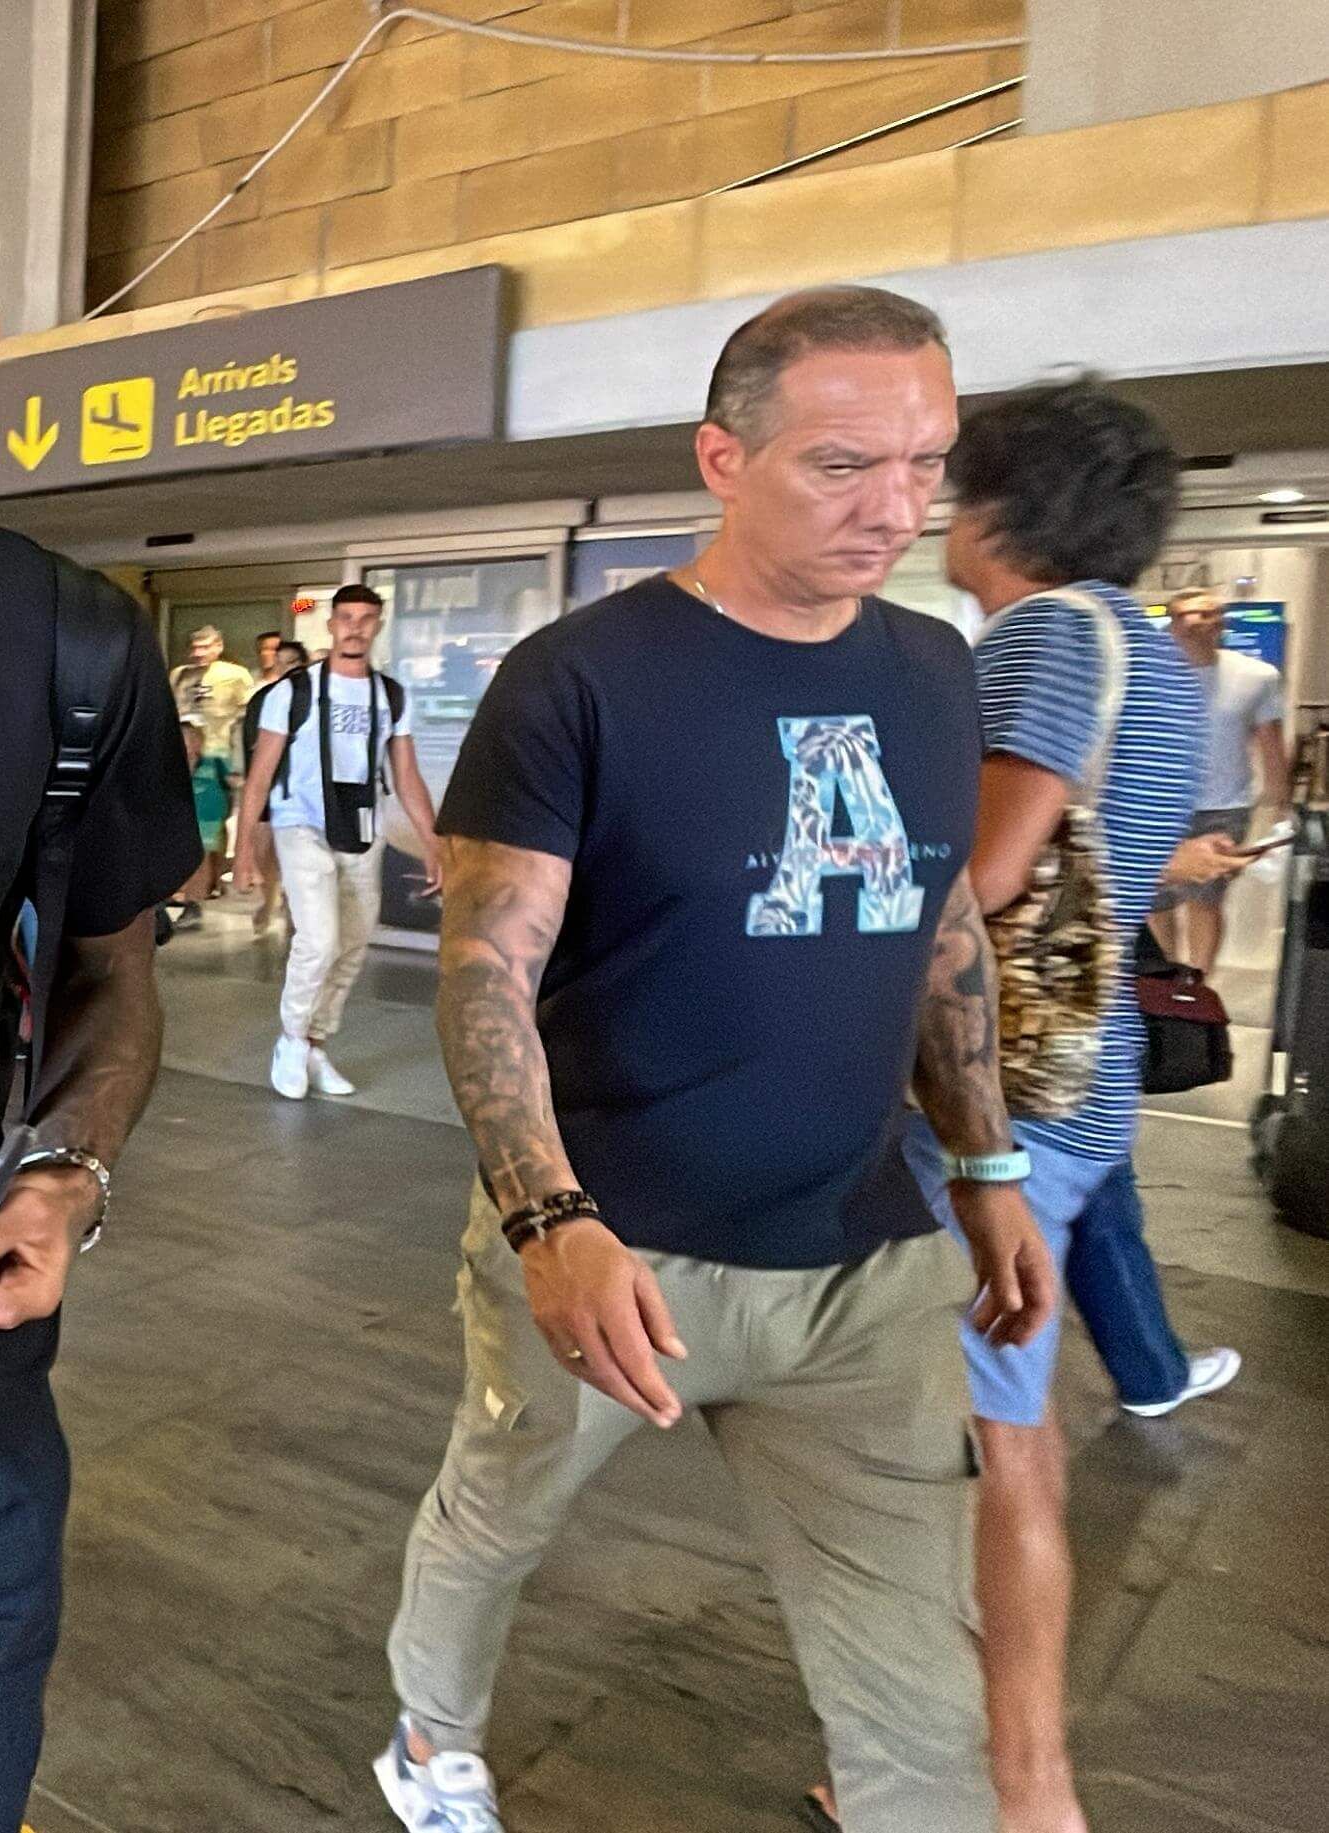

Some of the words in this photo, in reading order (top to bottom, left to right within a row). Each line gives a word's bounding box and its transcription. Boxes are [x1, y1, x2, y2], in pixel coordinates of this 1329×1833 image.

[178, 353, 298, 398] Arrivals
[175, 396, 336, 447] Llegadas
[745, 714, 925, 936] A
